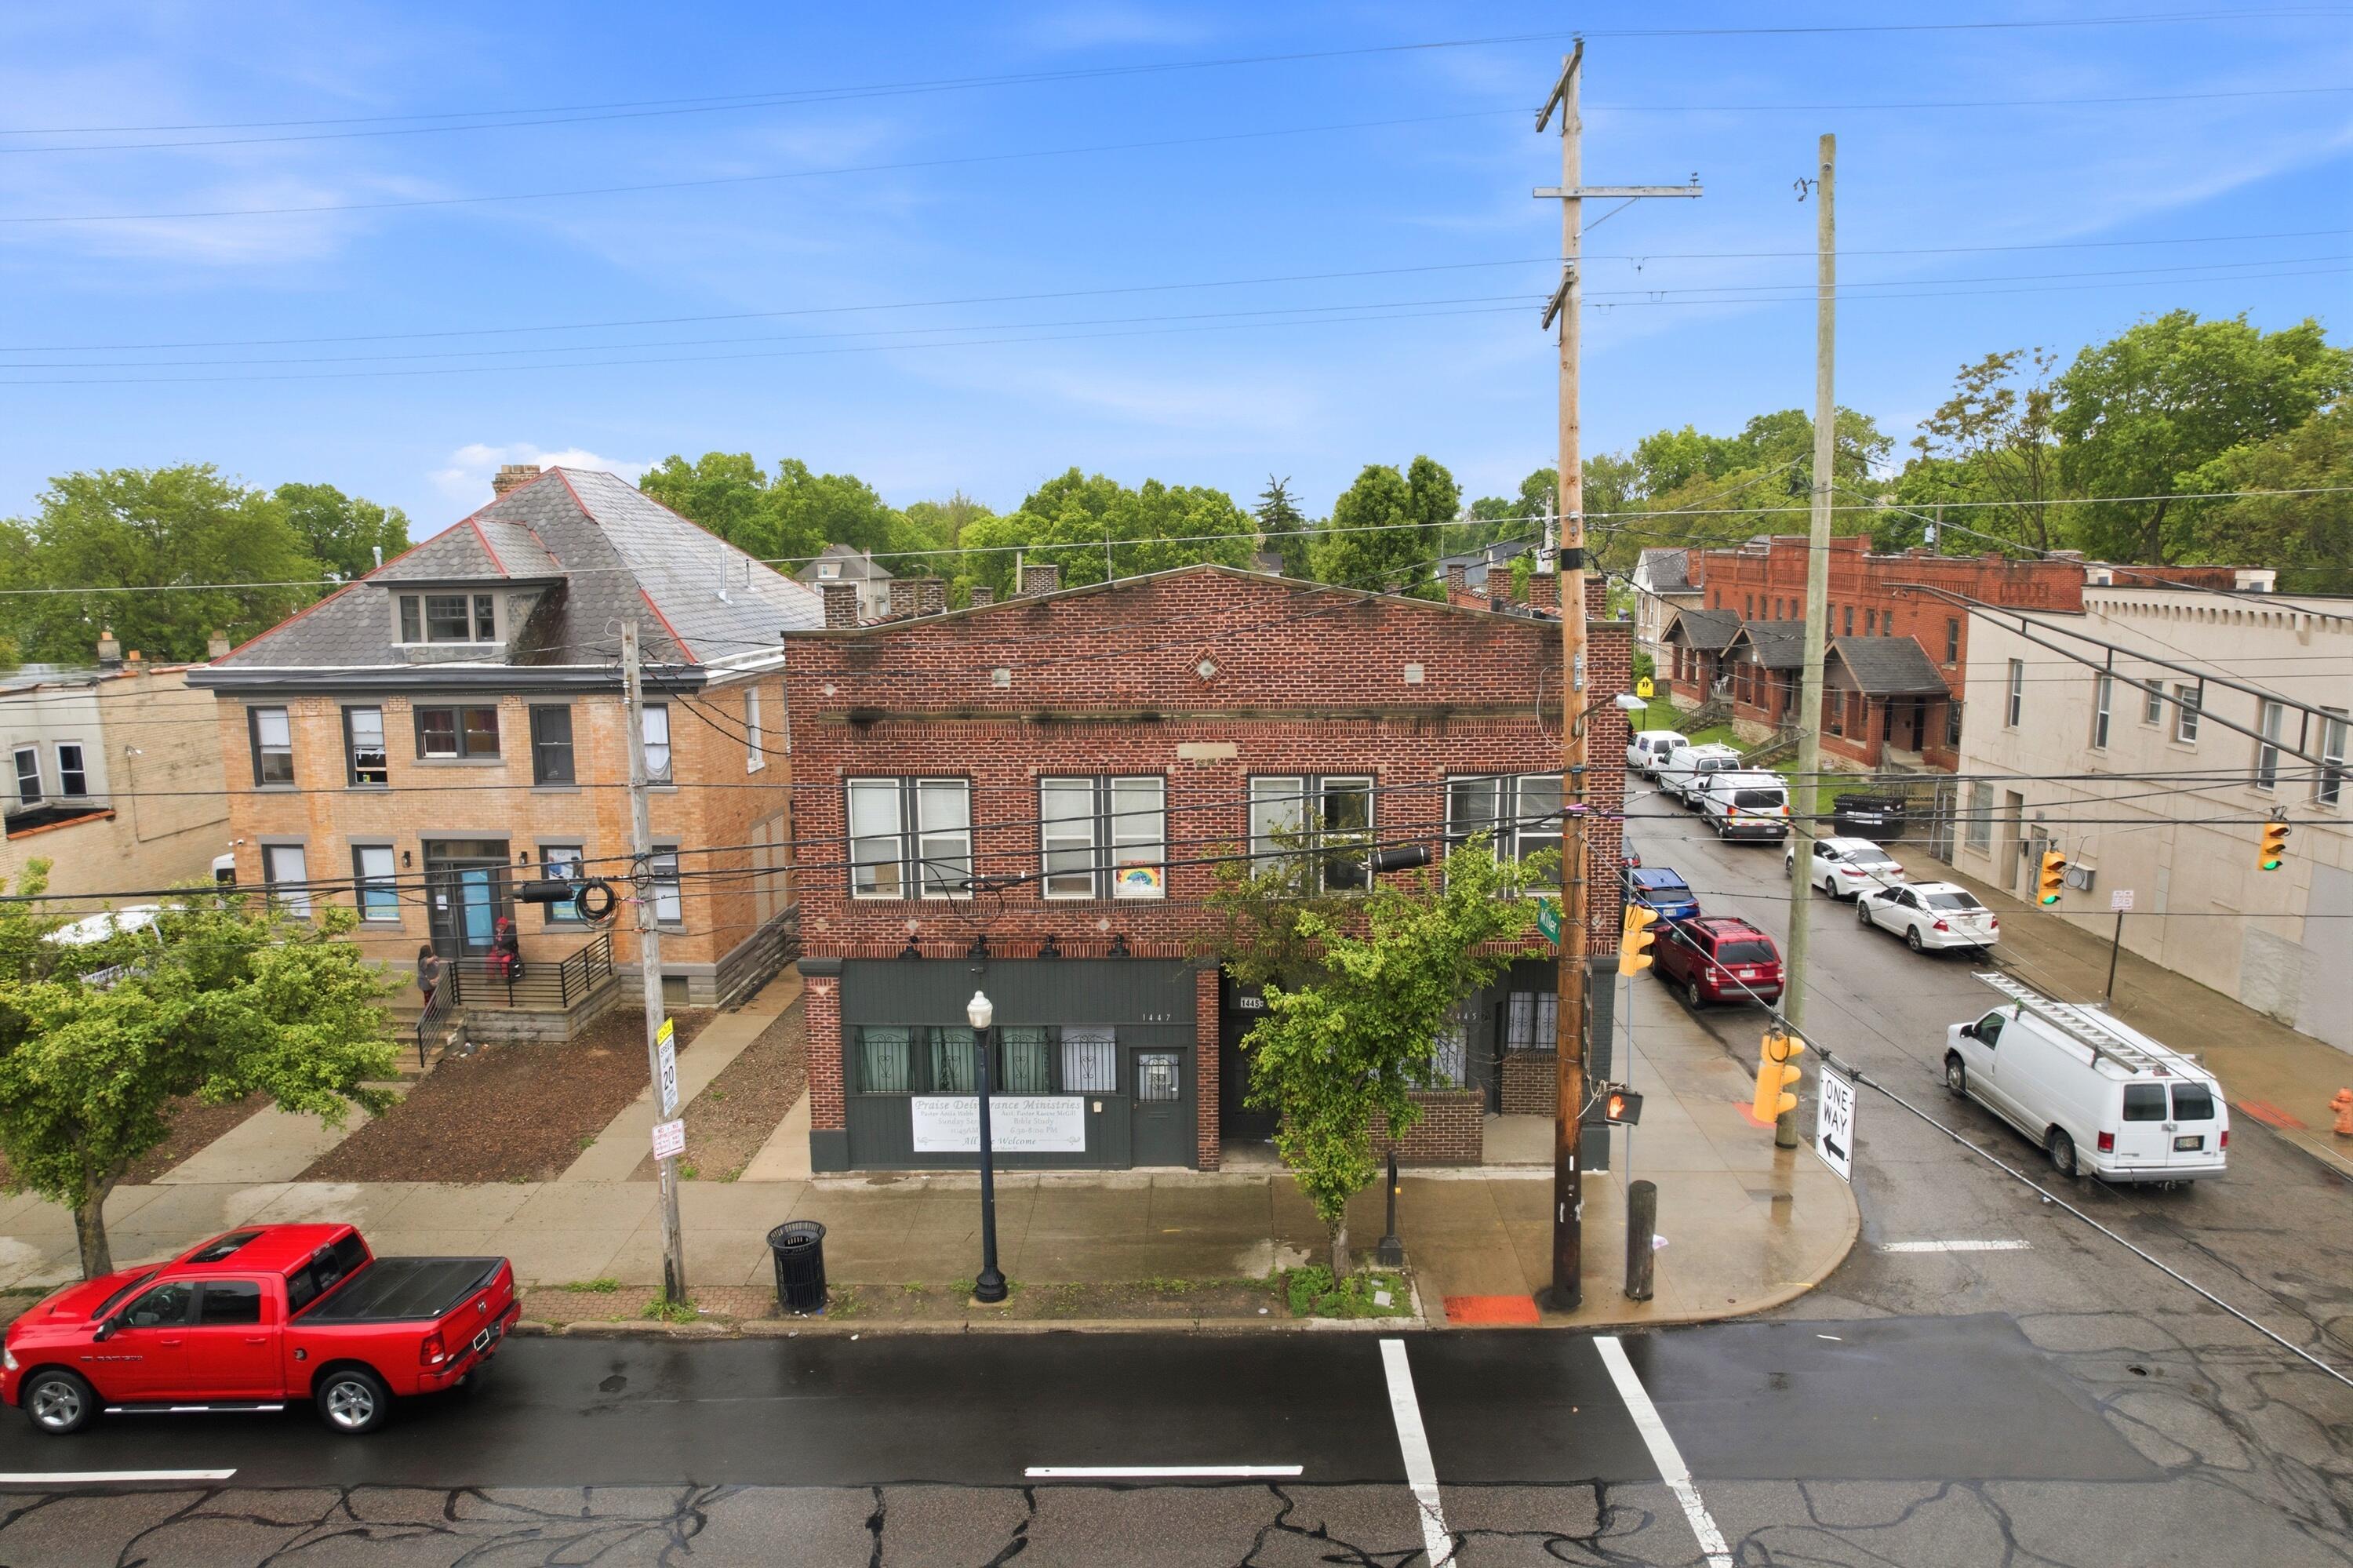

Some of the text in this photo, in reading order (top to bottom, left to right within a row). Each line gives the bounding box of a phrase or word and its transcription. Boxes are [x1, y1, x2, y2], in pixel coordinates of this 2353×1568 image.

[1540, 911, 1557, 934] Miller
[660, 1039, 673, 1057] SPEED
[664, 1065, 674, 1090] 20
[1826, 1079, 1848, 1112] ONE
[915, 1099, 1081, 1110] Praise Delirance Ministries
[938, 1117, 964, 1126] Sunday
[1033, 1117, 1054, 1126] Study
[1824, 1101, 1847, 1136] WAY
[962, 1136, 978, 1146] All
[998, 1137, 1036, 1145] Welcome
